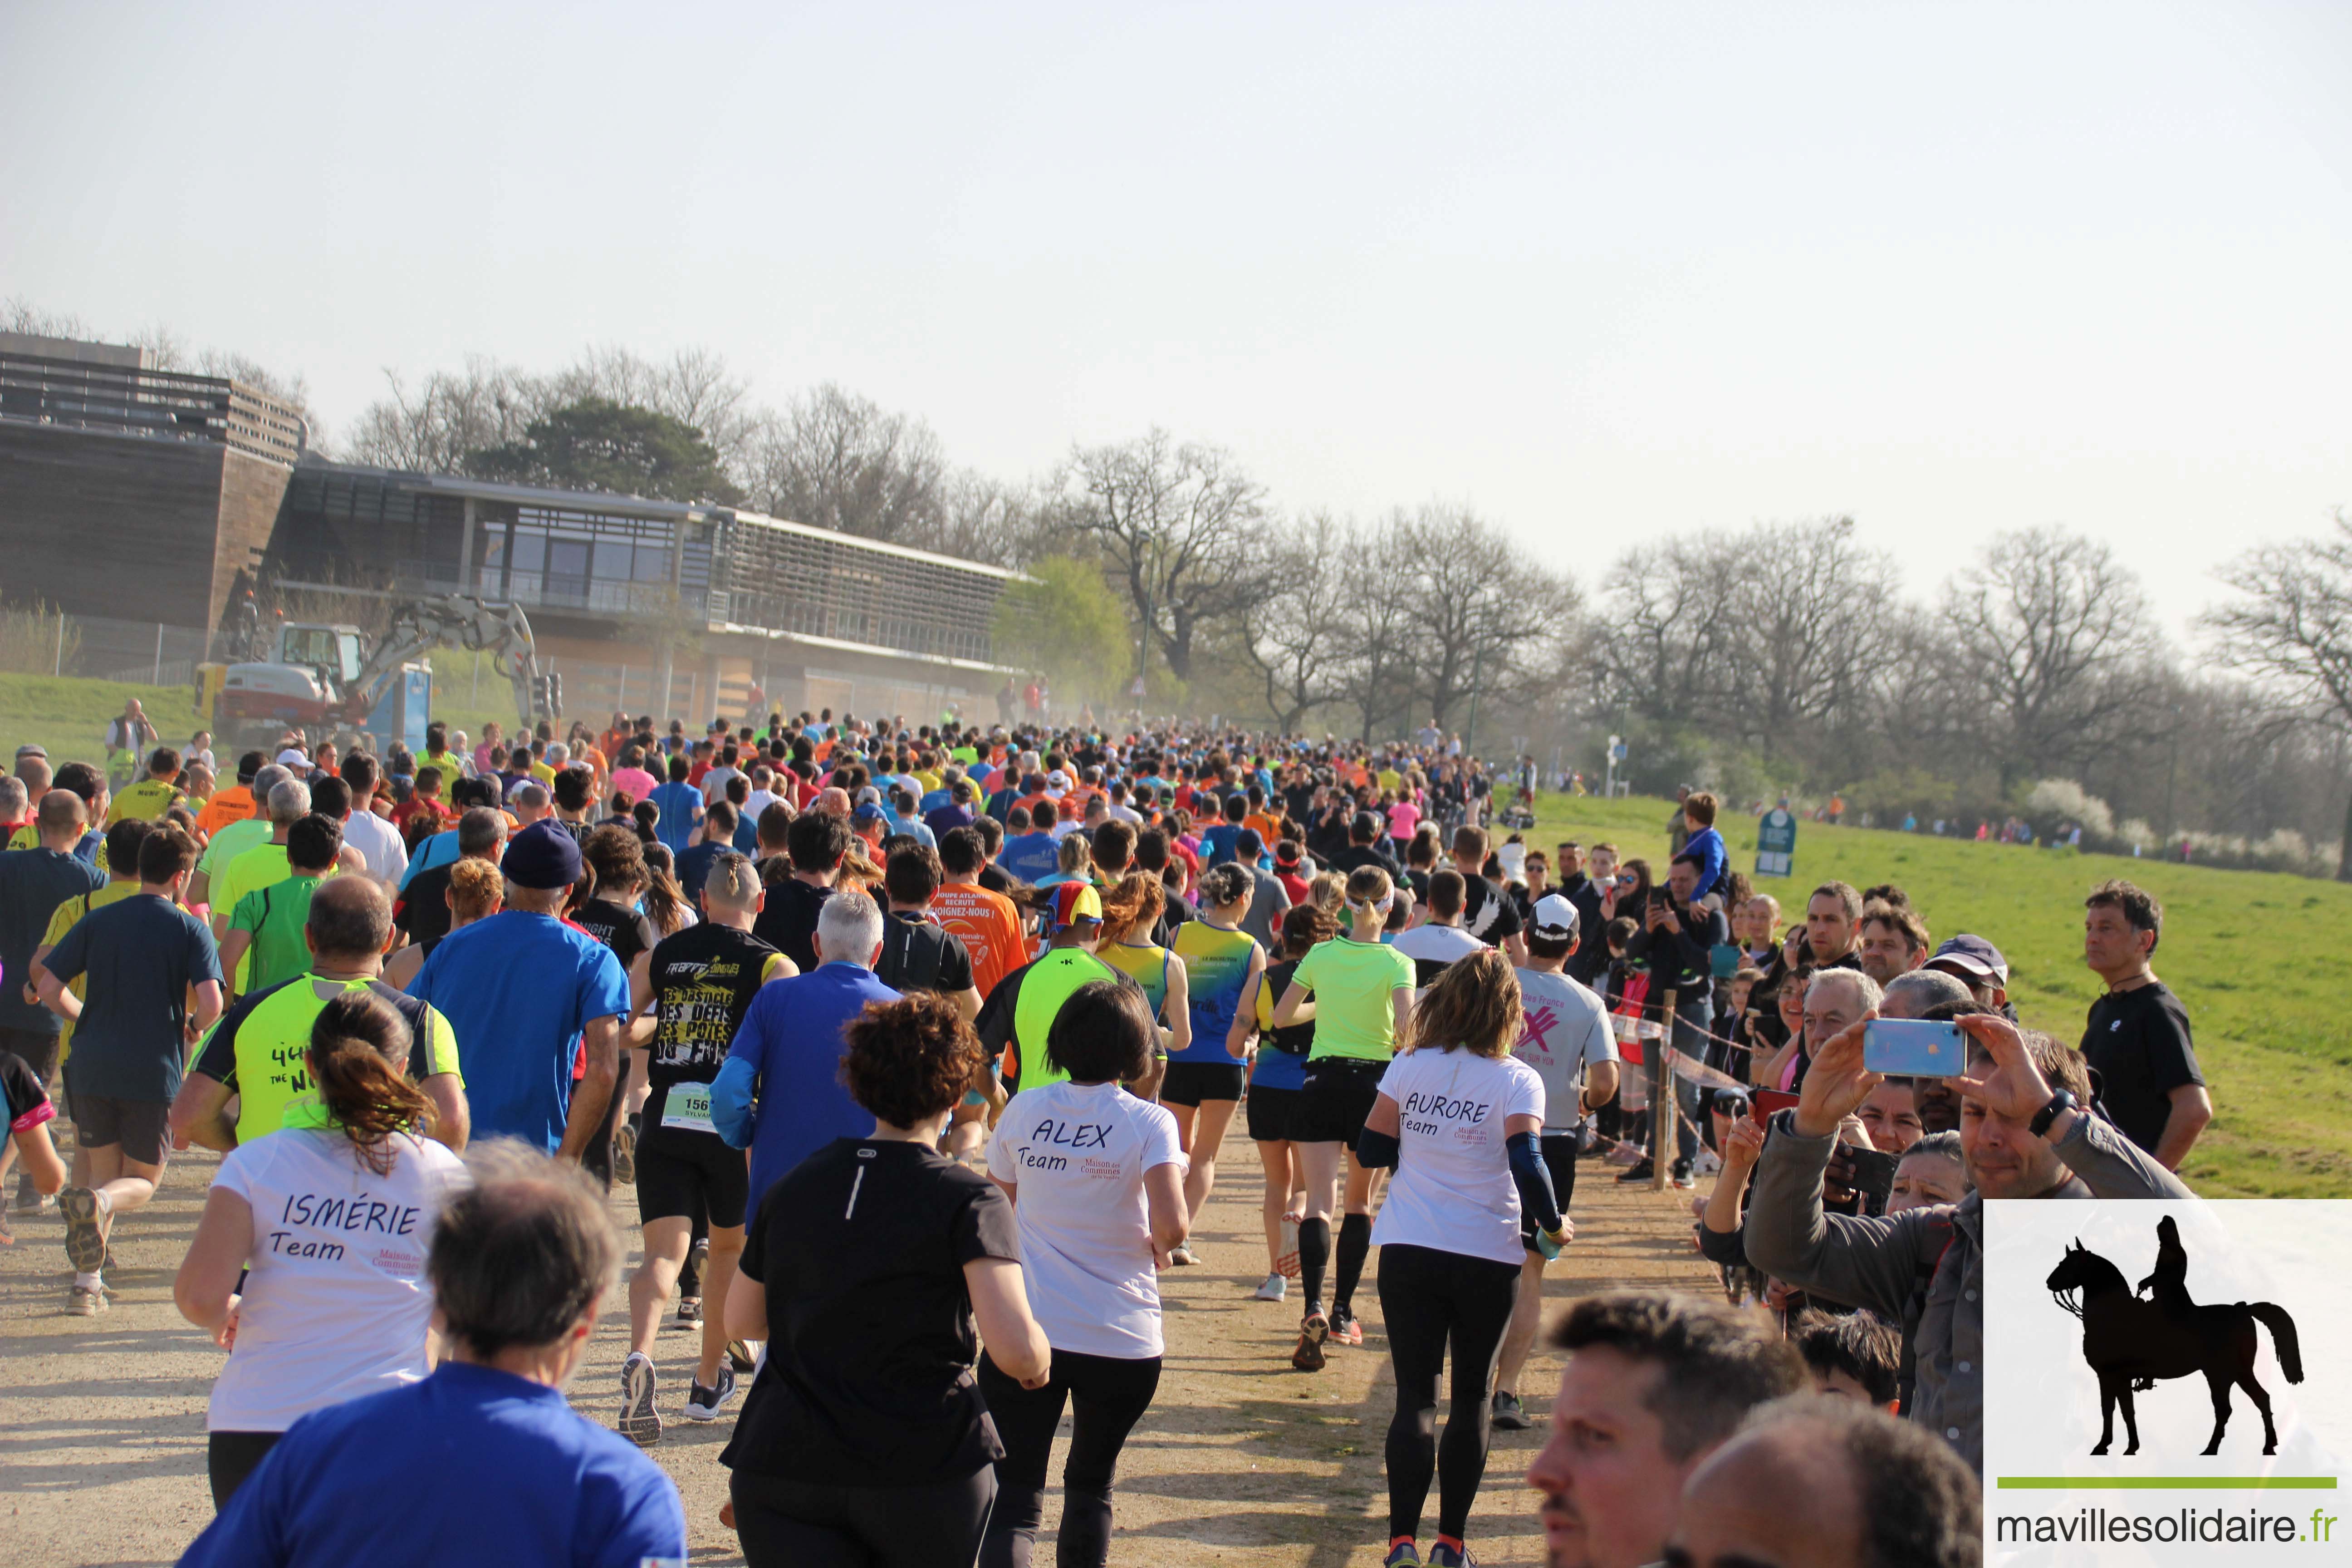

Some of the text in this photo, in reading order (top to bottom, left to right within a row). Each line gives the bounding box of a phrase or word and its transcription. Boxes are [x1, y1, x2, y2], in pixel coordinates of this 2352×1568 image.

[578, 921, 616, 937] NIGHT
[1539, 995, 1565, 1008] France
[1528, 1053, 1540, 1063] SUR
[1543, 1056, 1554, 1066] YON
[270, 1073, 287, 1085] THE
[1406, 1092, 1489, 1123] AURORE
[1400, 1112, 1438, 1136] Team
[1032, 1118, 1113, 1148] ALEX
[1454, 1132, 1487, 1141] Communes
[1458, 1127, 1479, 1135] Maison
[1018, 1147, 1067, 1171] Team
[1085, 1158, 1110, 1168] Maison
[1080, 1165, 1121, 1175] Communes
[283, 1192, 421, 1236] ISMÉRIE
[270, 1231, 345, 1261] Team
[380, 1248, 411, 1261] Maison
[372, 1257, 420, 1270] Communes
